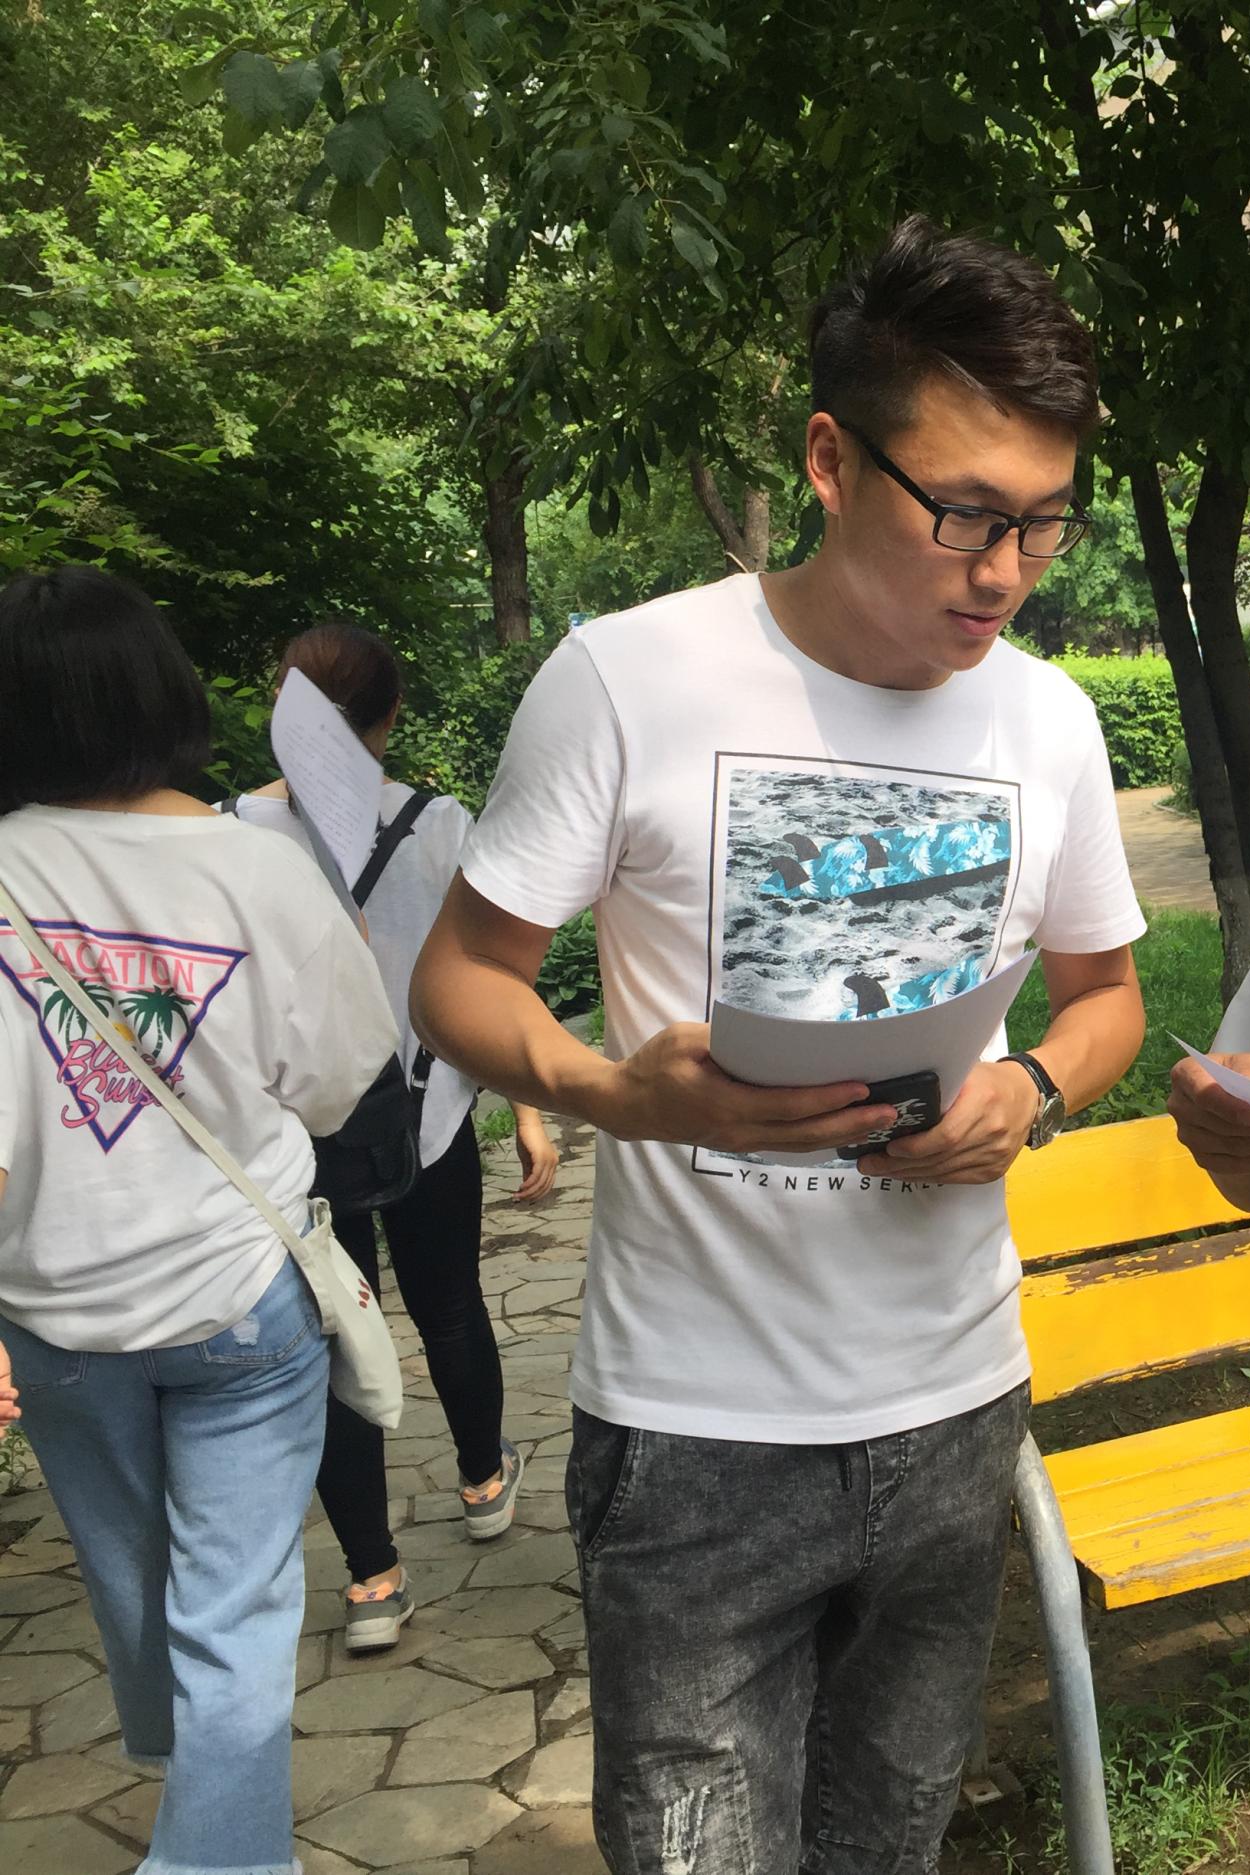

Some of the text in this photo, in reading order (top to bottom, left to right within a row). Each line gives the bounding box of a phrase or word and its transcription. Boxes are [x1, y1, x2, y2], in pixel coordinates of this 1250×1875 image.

[61, 1064, 186, 1129] Sunst
[784, 1175, 845, 1191] NEW
[859, 1175, 945, 1193] SER
